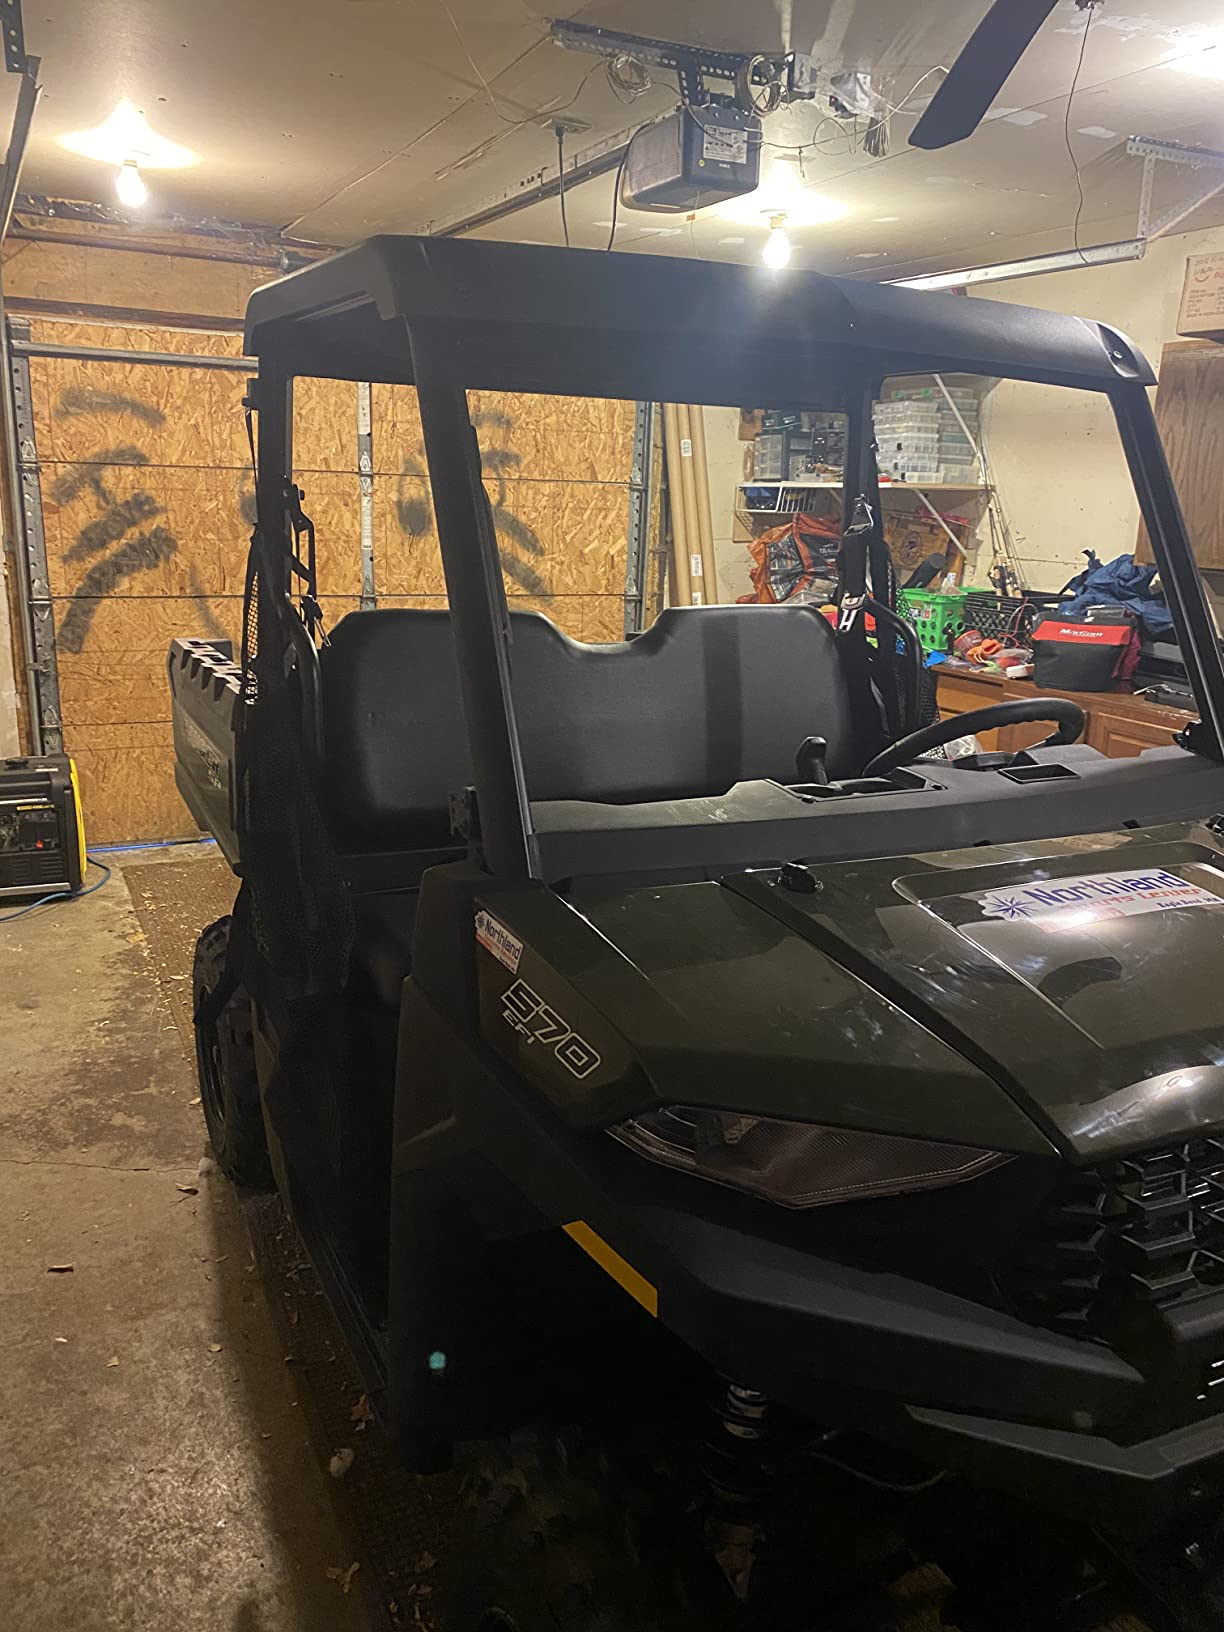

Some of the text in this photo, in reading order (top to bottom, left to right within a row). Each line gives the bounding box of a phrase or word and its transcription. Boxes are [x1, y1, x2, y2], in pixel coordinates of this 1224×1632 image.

[1022, 871, 1191, 907] Northland
[485, 918, 521, 960] Northland
[501, 978, 601, 1079] 570
